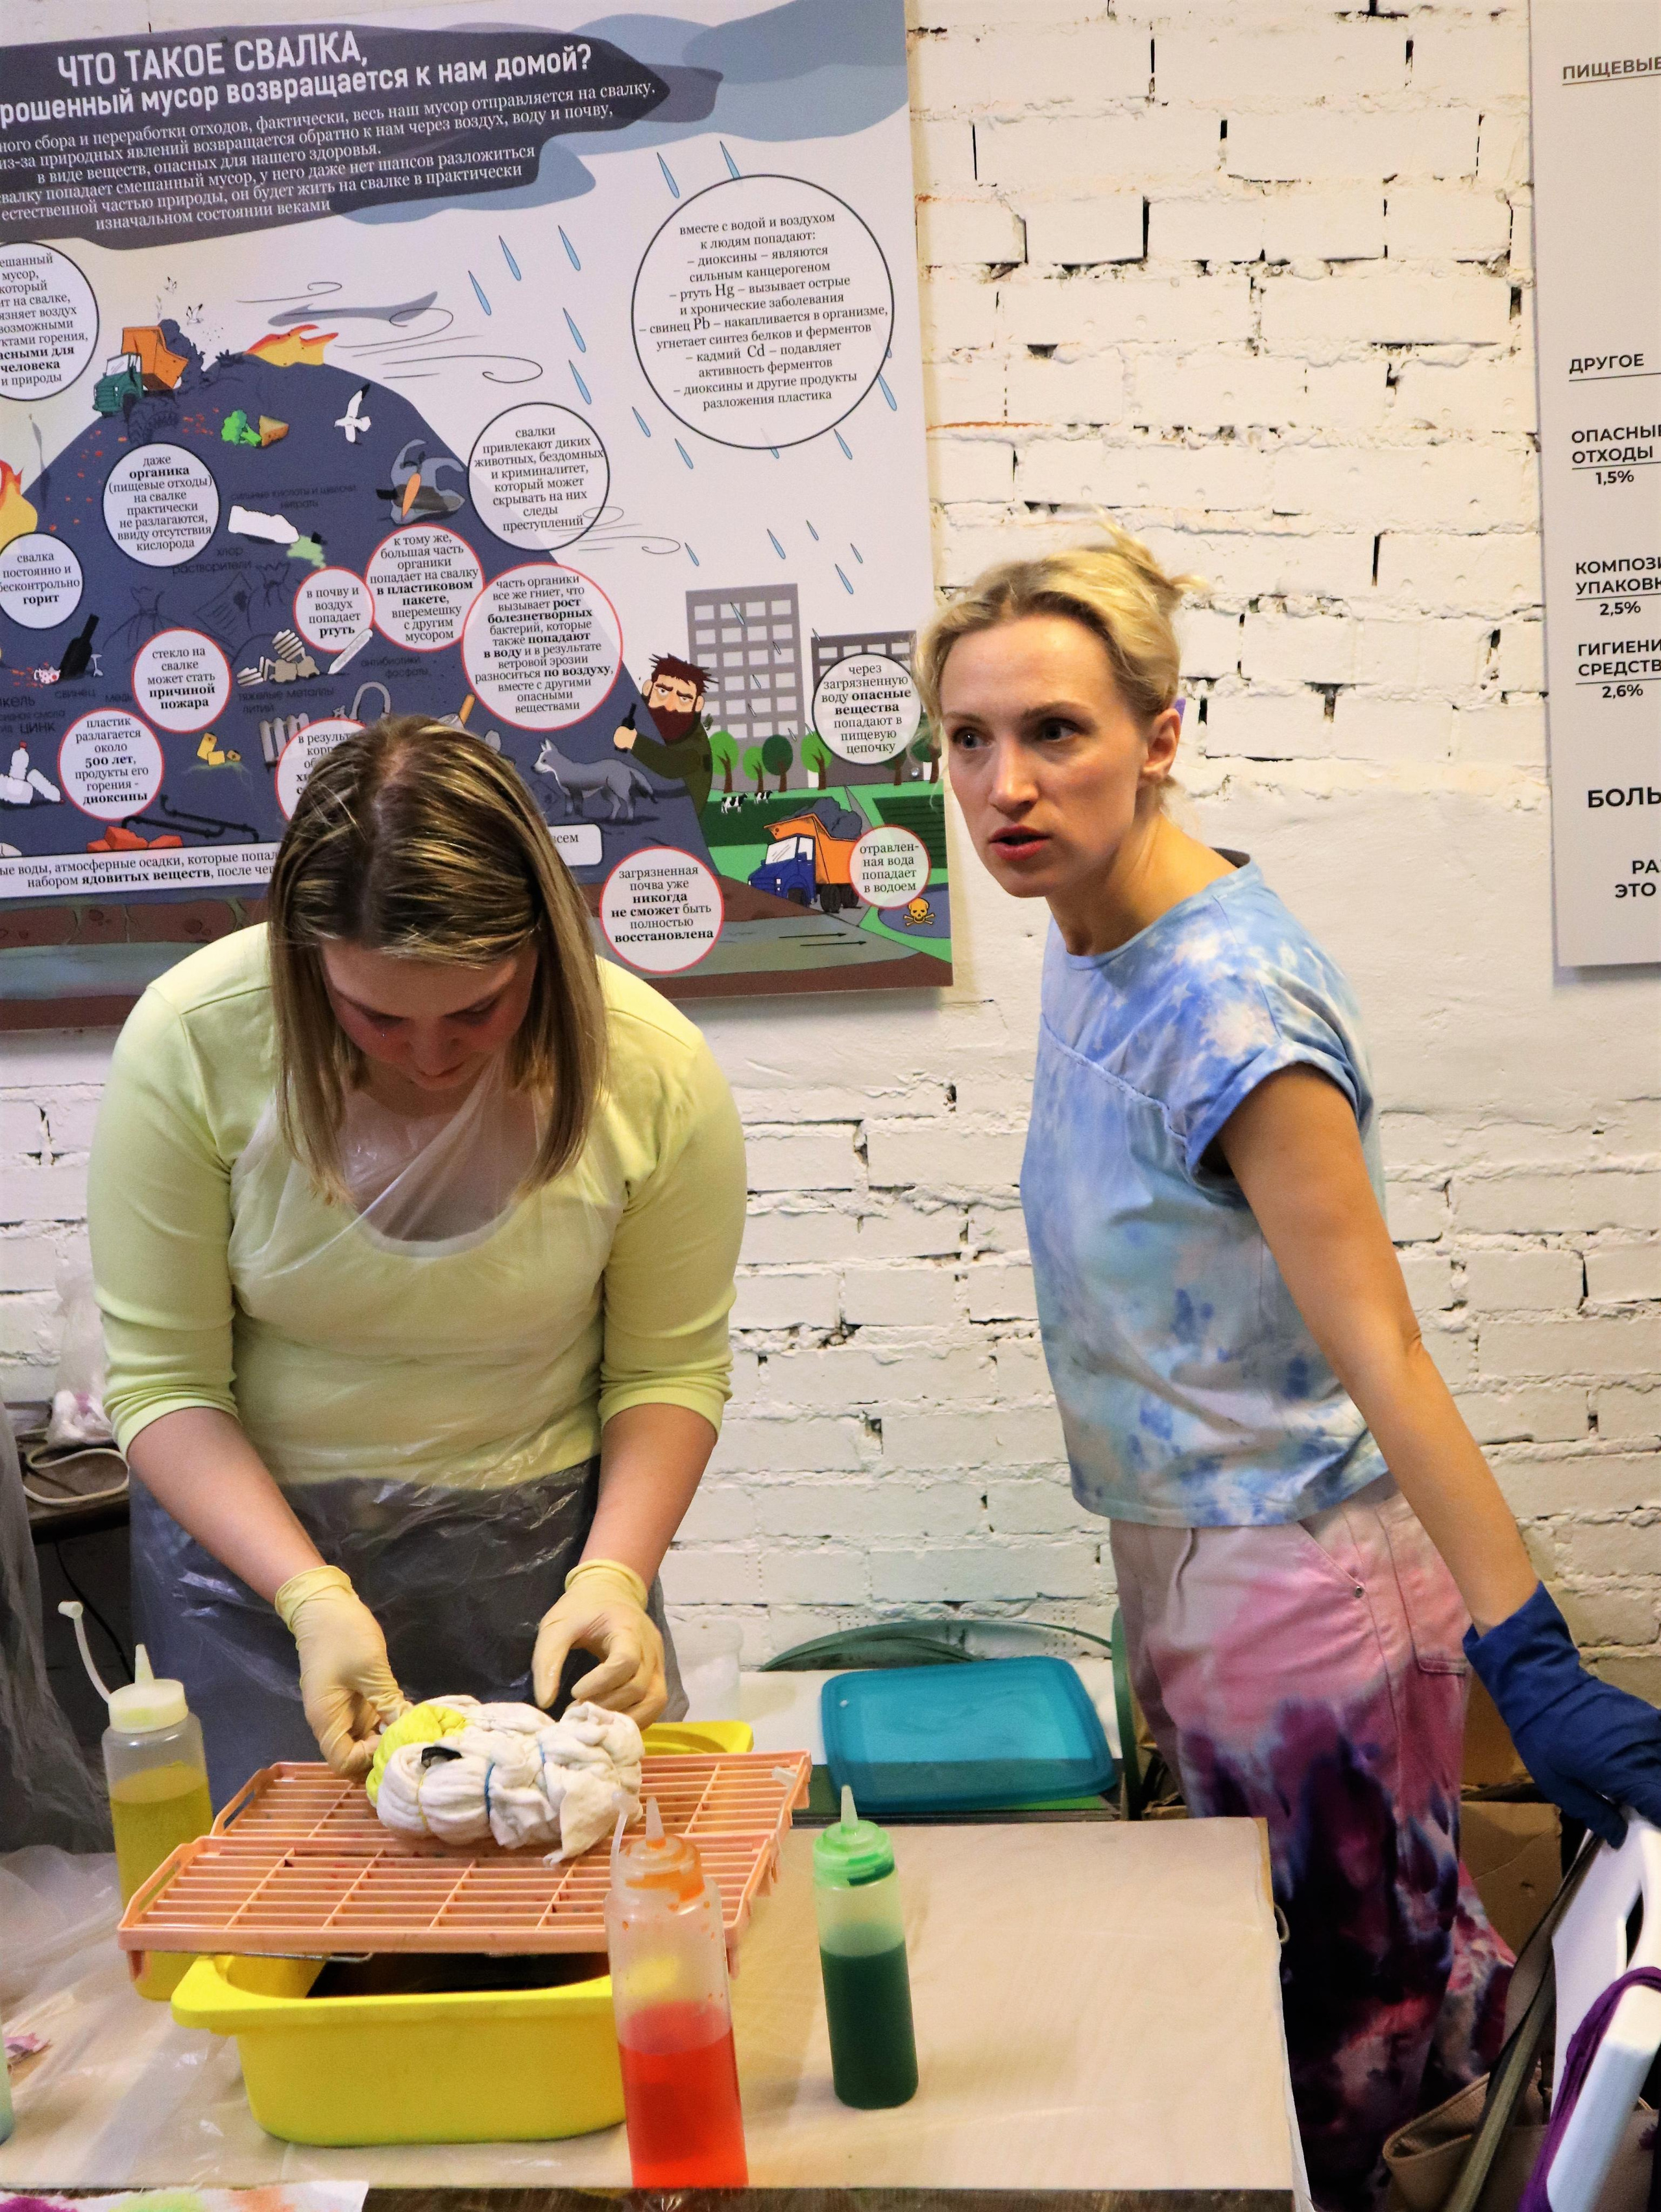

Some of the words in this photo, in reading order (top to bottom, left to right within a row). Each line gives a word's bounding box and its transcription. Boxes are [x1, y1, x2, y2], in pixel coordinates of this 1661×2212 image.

[58, 53, 115, 87] ЧТО
[125, 43, 224, 82] ТАКОЕ
[235, 31, 367, 71] СВАЛКА,
[1562, 56, 1661, 80] ПИЩЕВЫЕ
[141, 86, 218, 117] мусор
[227, 68, 408, 104] возвращается
[417, 66, 431, 86] к
[439, 60, 487, 84] нам
[495, 44, 590, 82] домой?
[35, 135, 76, 151] сбора
[80, 136, 88, 145] и
[93, 126, 186, 146] переработки
[190, 122, 252, 136] отходов,
[257, 113, 348, 132] фактически,
[353, 109, 384, 121] весь
[389, 106, 418, 117] наш
[424, 101, 468, 117] мусор
[472, 91, 573, 111] отправляется
[579, 88, 596, 100] на
[600, 83, 655, 97] свалку.
[38, 174, 45, 183] в
[49, 171, 82, 183] виде
[87, 165, 151, 179] веществ,
[154, 158, 217, 173] опасных
[221, 156, 247, 170] для
[252, 151, 306, 165] нашего
[309, 145, 381, 161] здоровья.
[2, 199, 97, 221] естественной
[102, 199, 153, 212] частью
[158, 193, 227, 208] природы,
[232, 191, 249, 201] он
[254, 182, 293, 202] будет
[297, 183, 335, 195] жить
[339, 181, 356, 191] на
[361, 176, 409, 189] свалке
[414, 175, 422, 184] в
[426, 165, 522, 187] практически
[96, 212, 193, 230] изначальном
[197, 206, 273, 221] состоянии
[278, 201, 330, 214] веками
[680, 225, 719, 235] вместе
[732, 217, 765, 230] водой
[781, 214, 834, 226] воздухом
[710, 238, 750, 249] людям
[755, 232, 815, 244] попадают:
[3, 271, 38, 282] мусор,
[690, 271, 742, 282] сильным
[747, 263, 829, 277] канцерогеном
[30, 295, 70, 305] свалке,
[691, 301, 766, 317] хронические
[770, 295, 843, 307] заболевания
[657, 338, 706, 352] угнетает
[710, 335, 747, 344] синтез
[751, 331, 792, 341] белков
[806, 324, 871, 339] ферментов
[1, 361, 60, 372] человека
[699, 365, 764, 378] активность
[768, 359, 832, 374] ферментов
[1569, 353, 1644, 374] ДРУГОЕ
[12, 374, 62, 387] природы
[703, 396, 774, 411] разложения
[779, 392, 832, 402] пластика
[516, 428, 555, 437] свалки
[483, 441, 552, 456] привлекают
[555, 439, 590, 449] диких
[1572, 446, 1653, 463] ОТХОДЫ
[143, 457, 171, 467] даже
[130, 468, 189, 481] органика
[1595, 470, 1634, 485] 1,5%
[109, 481, 164, 494] (пищевые
[167, 474, 212, 489] отходы)
[495, 478, 543, 492] который
[548, 478, 584, 488] может
[127, 504, 197, 518] практически
[523, 507, 557, 517] следы
[503, 516, 583, 531] преступлений
[137, 537, 194, 552] кислорода
[17, 553, 54, 563] свалка
[398, 559, 451, 572] органики
[1576, 557, 1661, 574] КОМПОЗ
[528, 576, 579, 589] органики
[23, 595, 59, 606] горит
[315, 601, 353, 611] воздух
[403, 596, 449, 605] пакете,
[1599, 601, 1641, 616] 2,5%
[309, 613, 361, 624] попадает
[488, 610, 592, 624] болезнетворных
[320, 627, 354, 638] ртуть
[490, 622, 542, 636] бактерий,
[547, 621, 592, 632] которые
[406, 630, 454, 642] мусором
[152, 649, 189, 659] стекло
[162, 662, 198, 671] свалке
[499, 656, 546, 670] ветровой
[550, 653, 588, 668] эрозии
[849, 665, 881, 676] через
[824, 677, 908, 690] загрязненную
[150, 683, 215, 699] причиной
[518, 689, 572, 701] опасными
[822, 694, 848, 703] воду
[852, 690, 911, 700] опасные
[1603, 684, 1643, 699] 2,6%
[161, 699, 209, 709] пожара
[515, 702, 579, 712] веществами
[836, 705, 899, 715] вещества
[87, 718, 130, 728] пластик
[834, 718, 892, 728] попадают
[76, 731, 141, 744] разлагается
[841, 731, 897, 741] пищевую
[847, 744, 895, 754] цепочку
[86, 758, 108, 768] 500
[84, 794, 147, 805] диоксины
[860, 844, 918, 856] отравлен-
[18, 866, 51, 875] воды,
[55, 860, 136, 873] атмосферные
[139, 858, 184, 868] осадки,
[188, 854, 237, 866] которые
[888, 857, 914, 866] вода
[28, 876, 78, 888] набором
[82, 873, 149, 885] ядовитых
[153, 869, 213, 881] веществ,
[218, 868, 251, 876] после
[620, 868, 698, 880] загрязненная
[863, 870, 916, 880] попадает
[631, 882, 663, 890] почва
[667, 881, 689, 892] уже
[874, 883, 915, 893] водоем
[1615, 882, 1656, 898] ЭТО
[633, 890, 687, 903] никогда
[631, 907, 679, 916] сможет
[683, 903, 711, 914] быть
[631, 919, 693, 929] полностью
[615, 930, 714, 942] восстановлена
